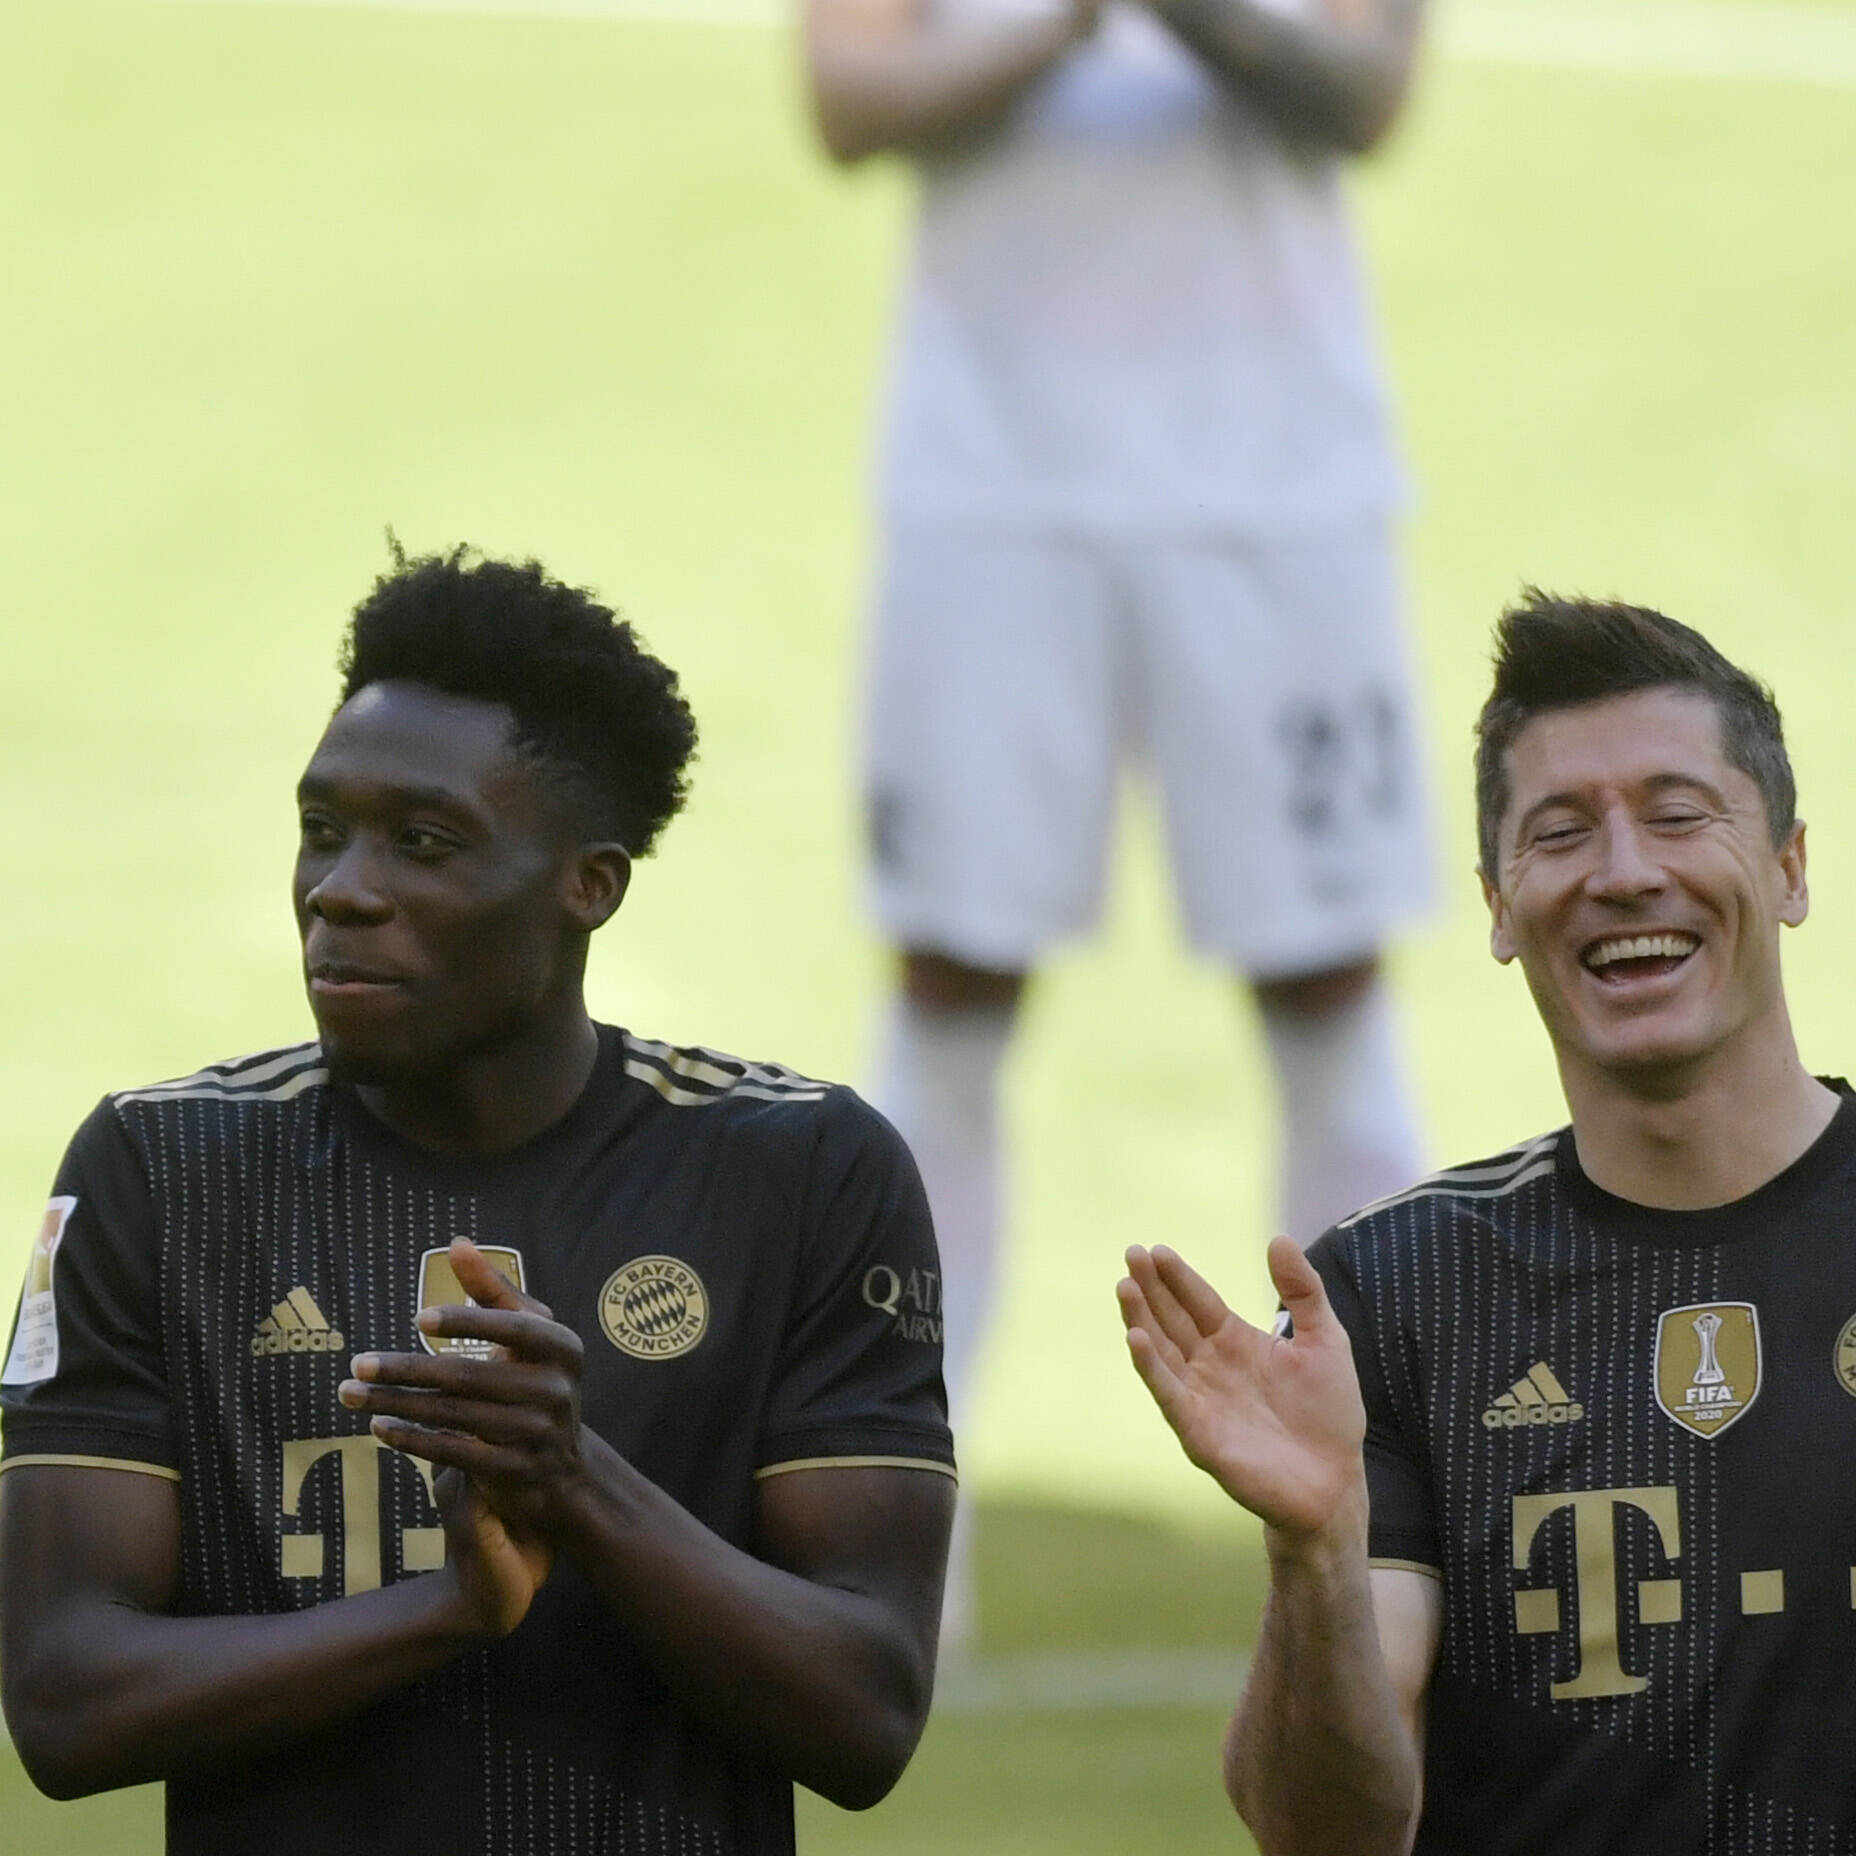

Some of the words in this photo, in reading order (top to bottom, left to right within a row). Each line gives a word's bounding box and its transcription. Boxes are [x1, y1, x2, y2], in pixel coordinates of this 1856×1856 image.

[608, 1283, 627, 1305] FC
[626, 1264, 698, 1297] BAYERN
[862, 1265, 943, 1316] QAT
[251, 1328, 345, 1357] adidas
[613, 1314, 701, 1351] MÜNCHEN
[1685, 1385, 1732, 1403] FIFA
[1481, 1403, 1584, 1427] adidas
